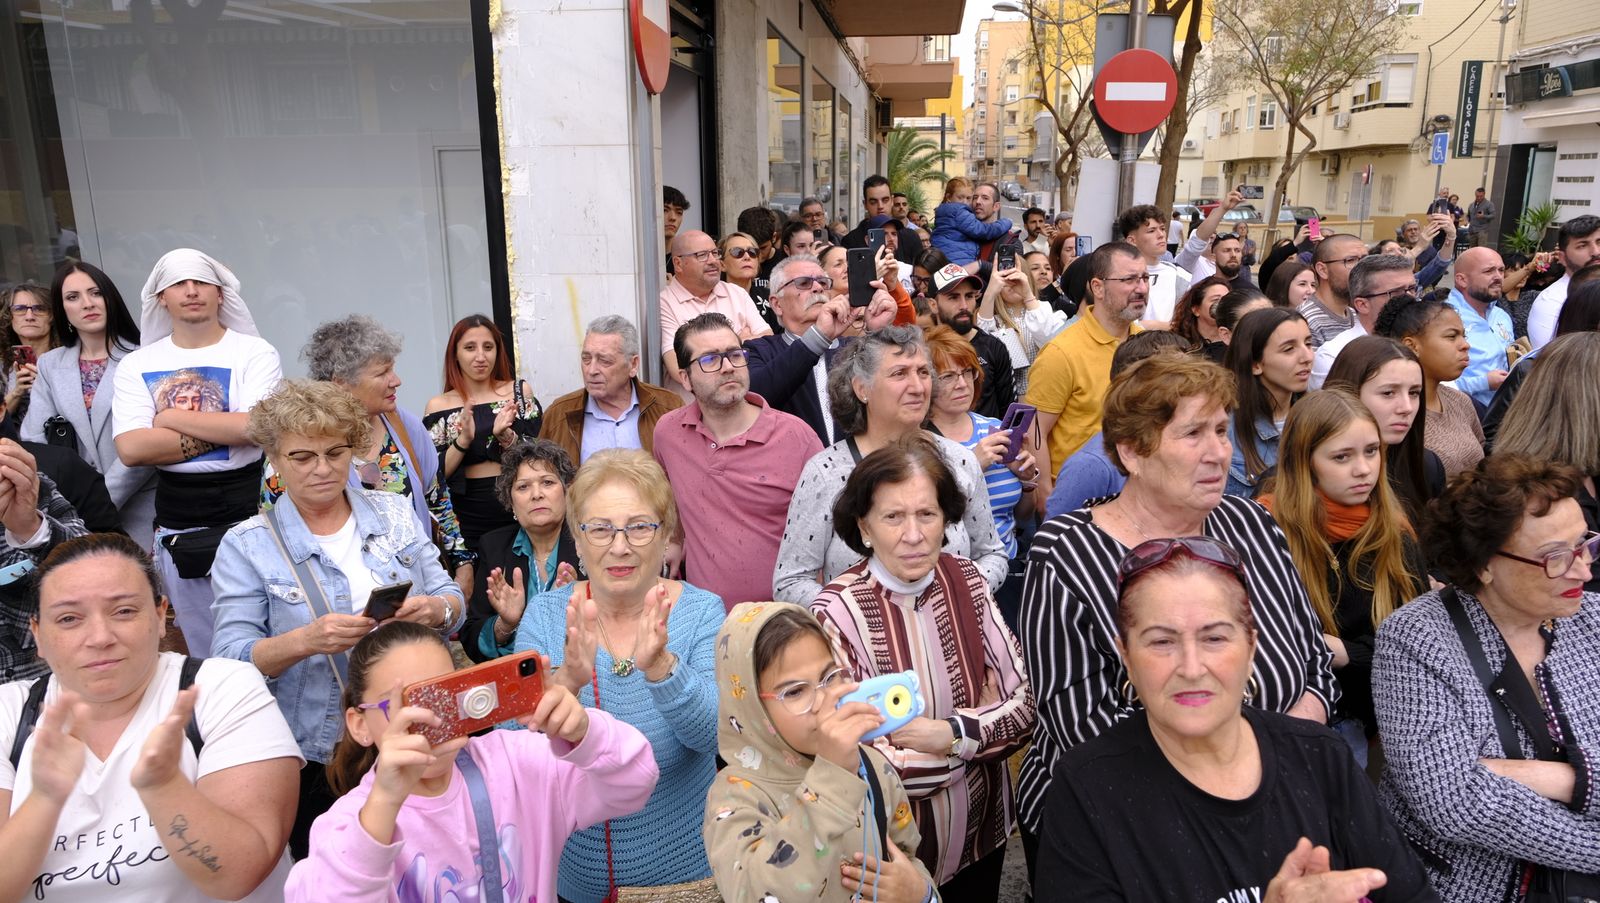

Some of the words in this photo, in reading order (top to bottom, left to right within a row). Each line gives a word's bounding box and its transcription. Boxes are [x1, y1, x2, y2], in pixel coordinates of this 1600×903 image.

[1461, 119, 1471, 155] ALPES
[54, 815, 155, 852] RFECTL
[32, 844, 170, 901] perfec
